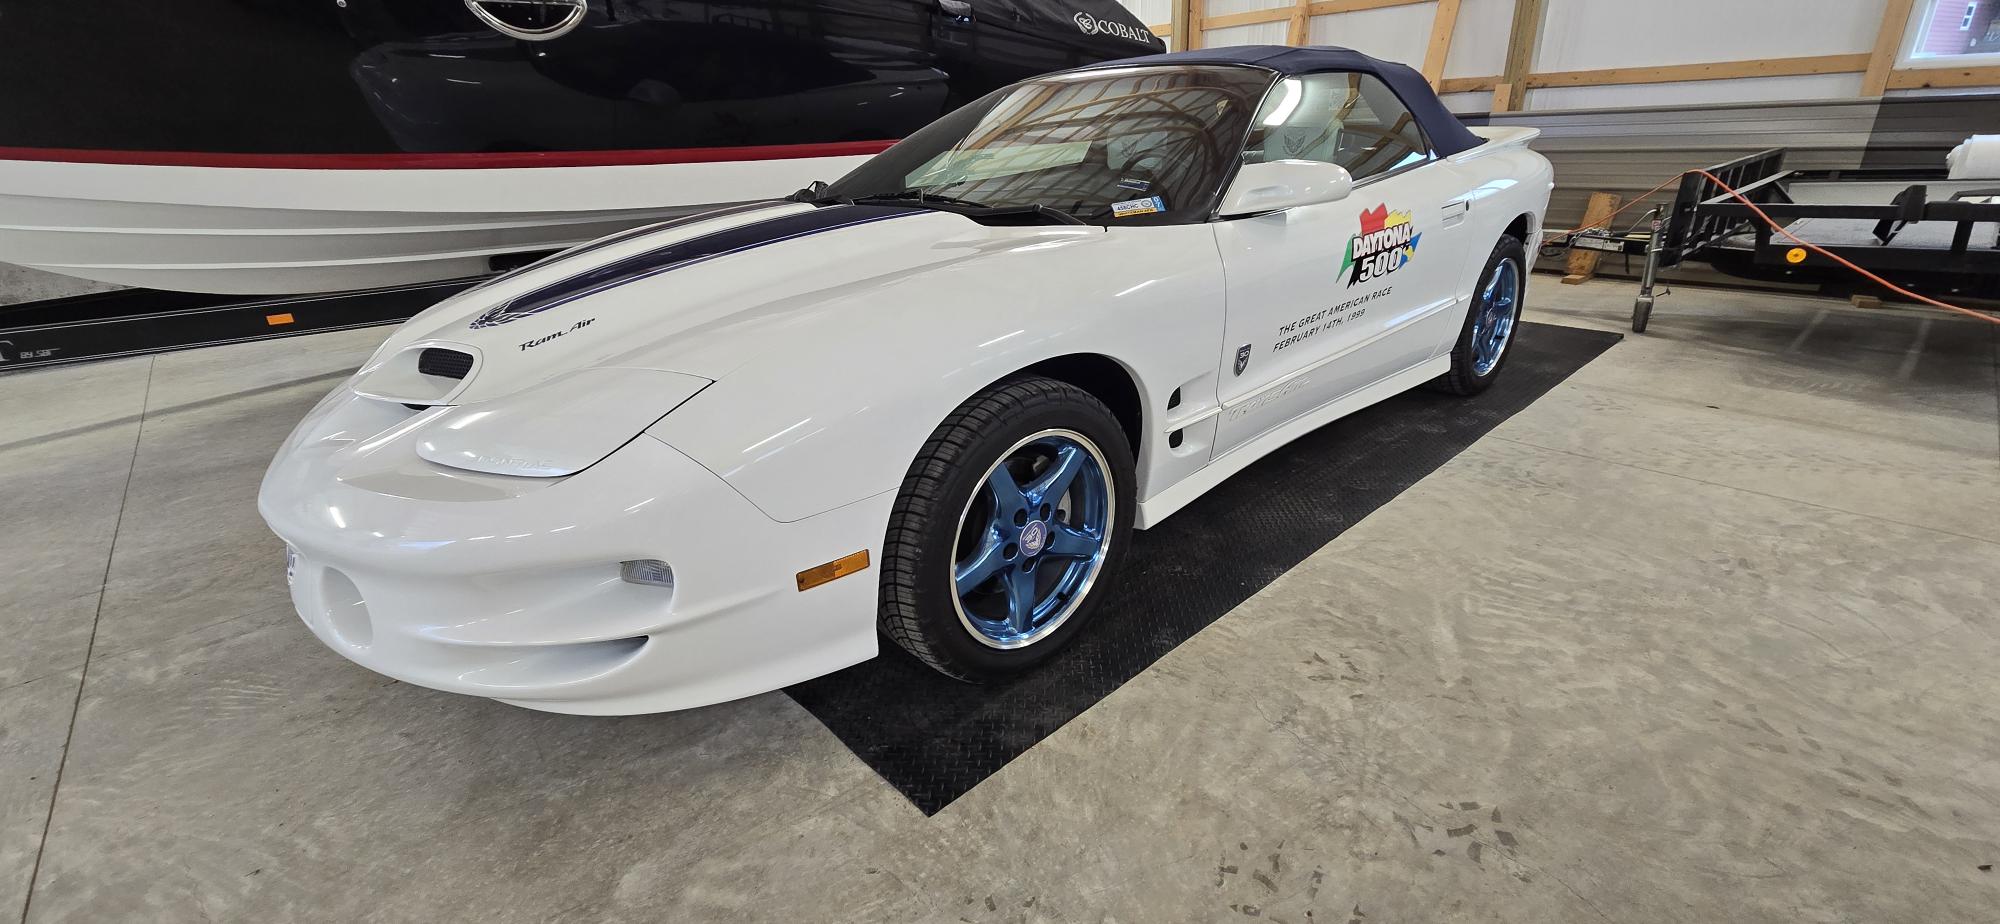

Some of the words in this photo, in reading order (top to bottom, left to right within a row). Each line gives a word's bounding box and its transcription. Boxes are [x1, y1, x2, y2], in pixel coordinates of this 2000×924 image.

[1098, 20, 1150, 43] COBALT
[1353, 223, 1411, 259] DAYTONA
[1359, 248, 1403, 282] 500
[1279, 321, 1297, 336] THE
[1299, 310, 1327, 328] GREAT
[1328, 294, 1370, 317] AMERICAN
[1371, 286, 1393, 301] RACE
[519, 331, 568, 352] Ram
[569, 318, 596, 333] Air
[1272, 326, 1320, 353] FEBRUARY
[1322, 318, 1344, 332] 14TH,
[1347, 308, 1366, 322] 1999
